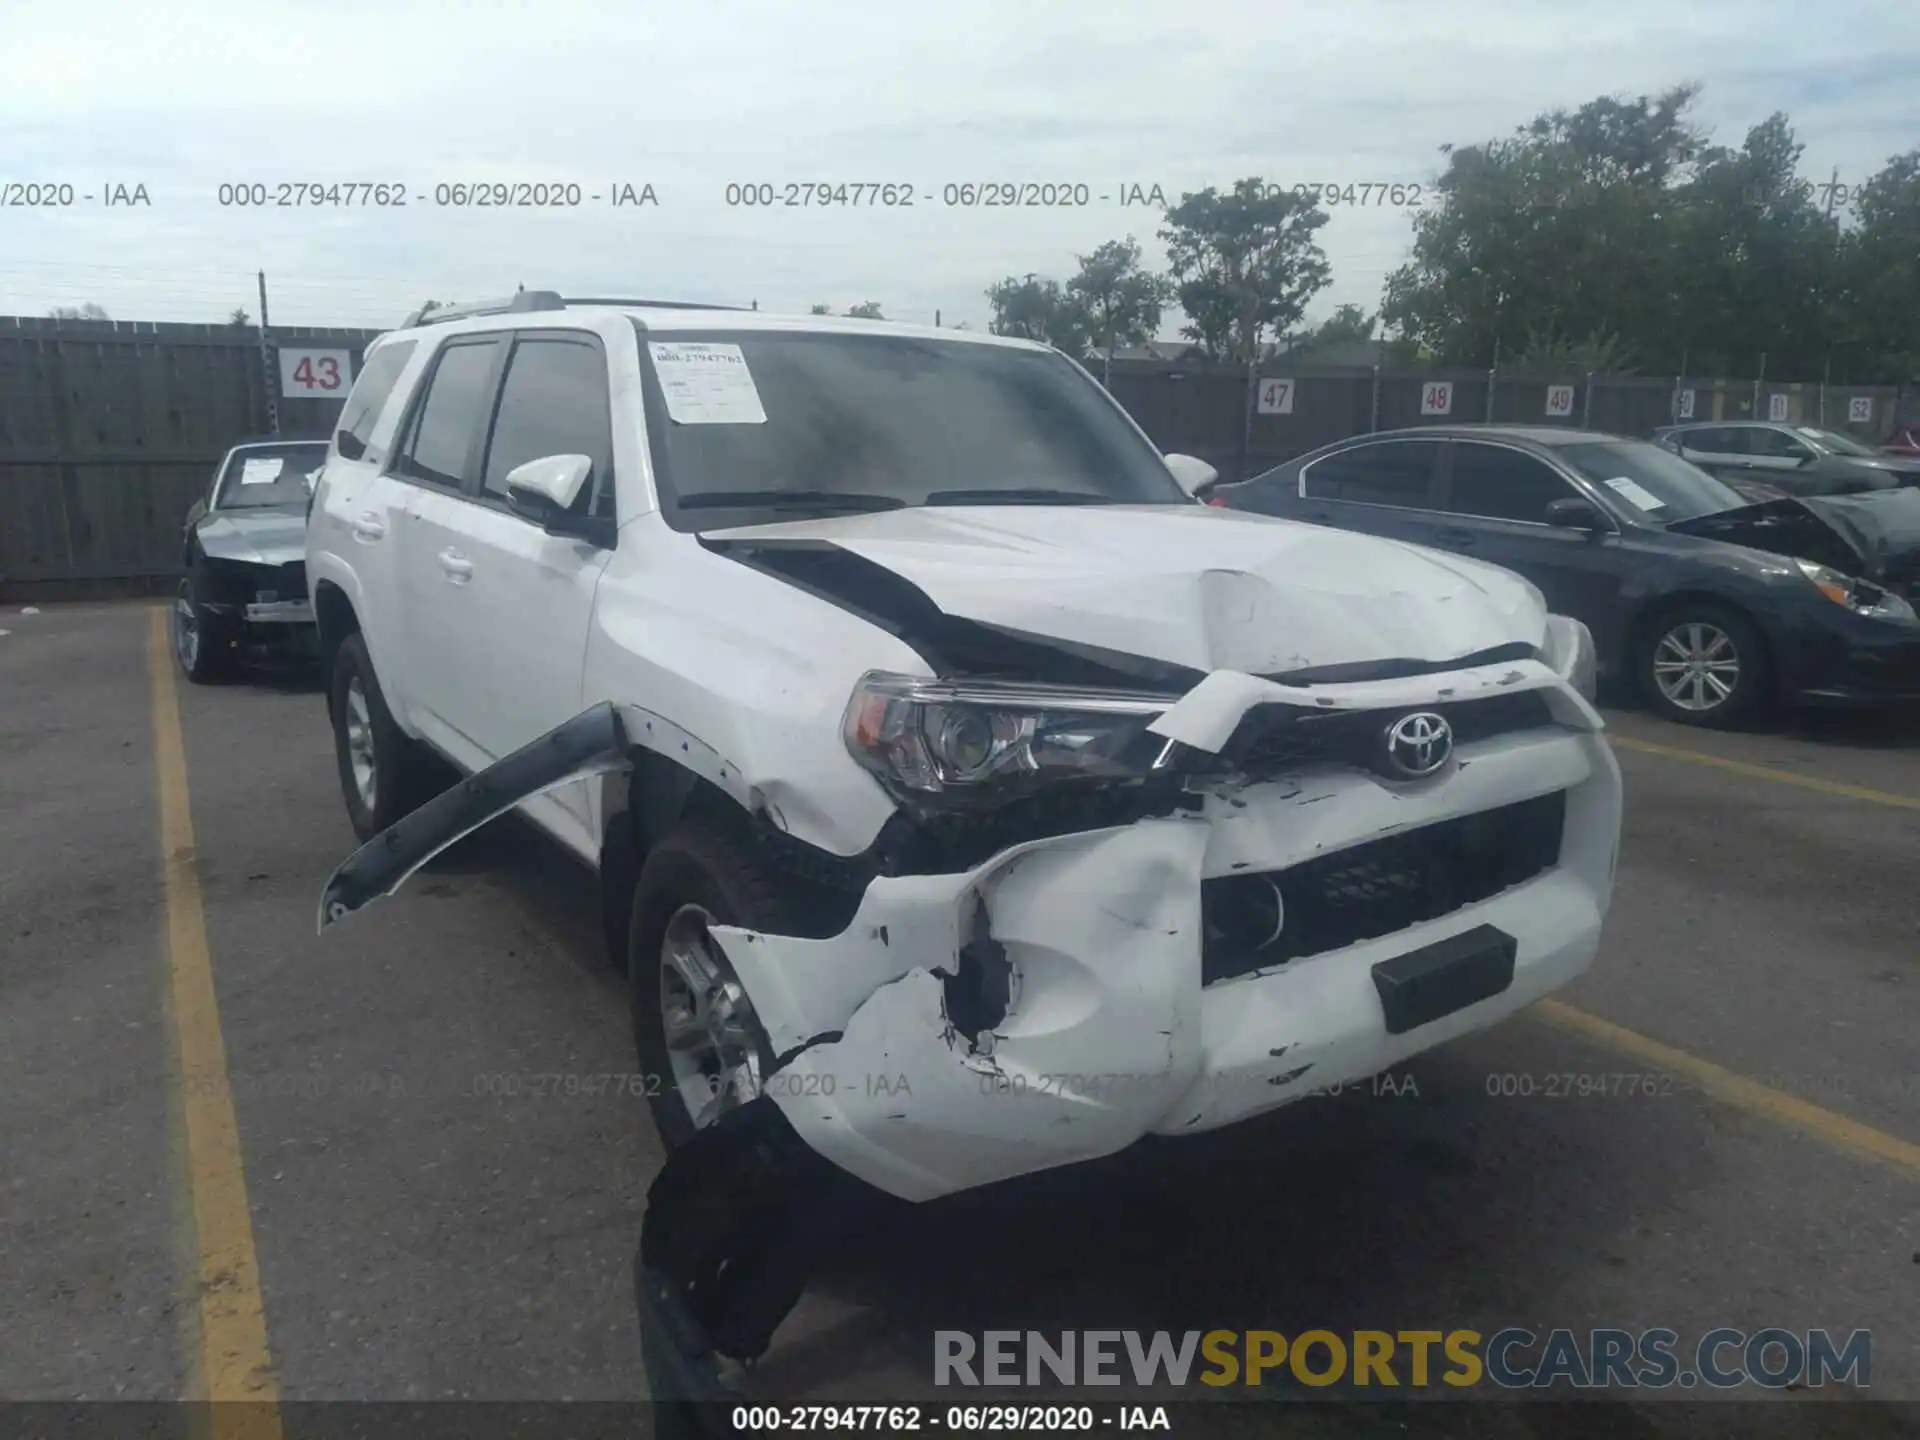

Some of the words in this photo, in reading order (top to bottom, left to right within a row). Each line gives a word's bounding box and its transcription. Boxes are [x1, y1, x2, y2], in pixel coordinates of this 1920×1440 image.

[293, 356, 342, 391] 43
[1263, 383, 1289, 408] 47
[1426, 386, 1447, 410] 48
[1549, 389, 1569, 412] 49
